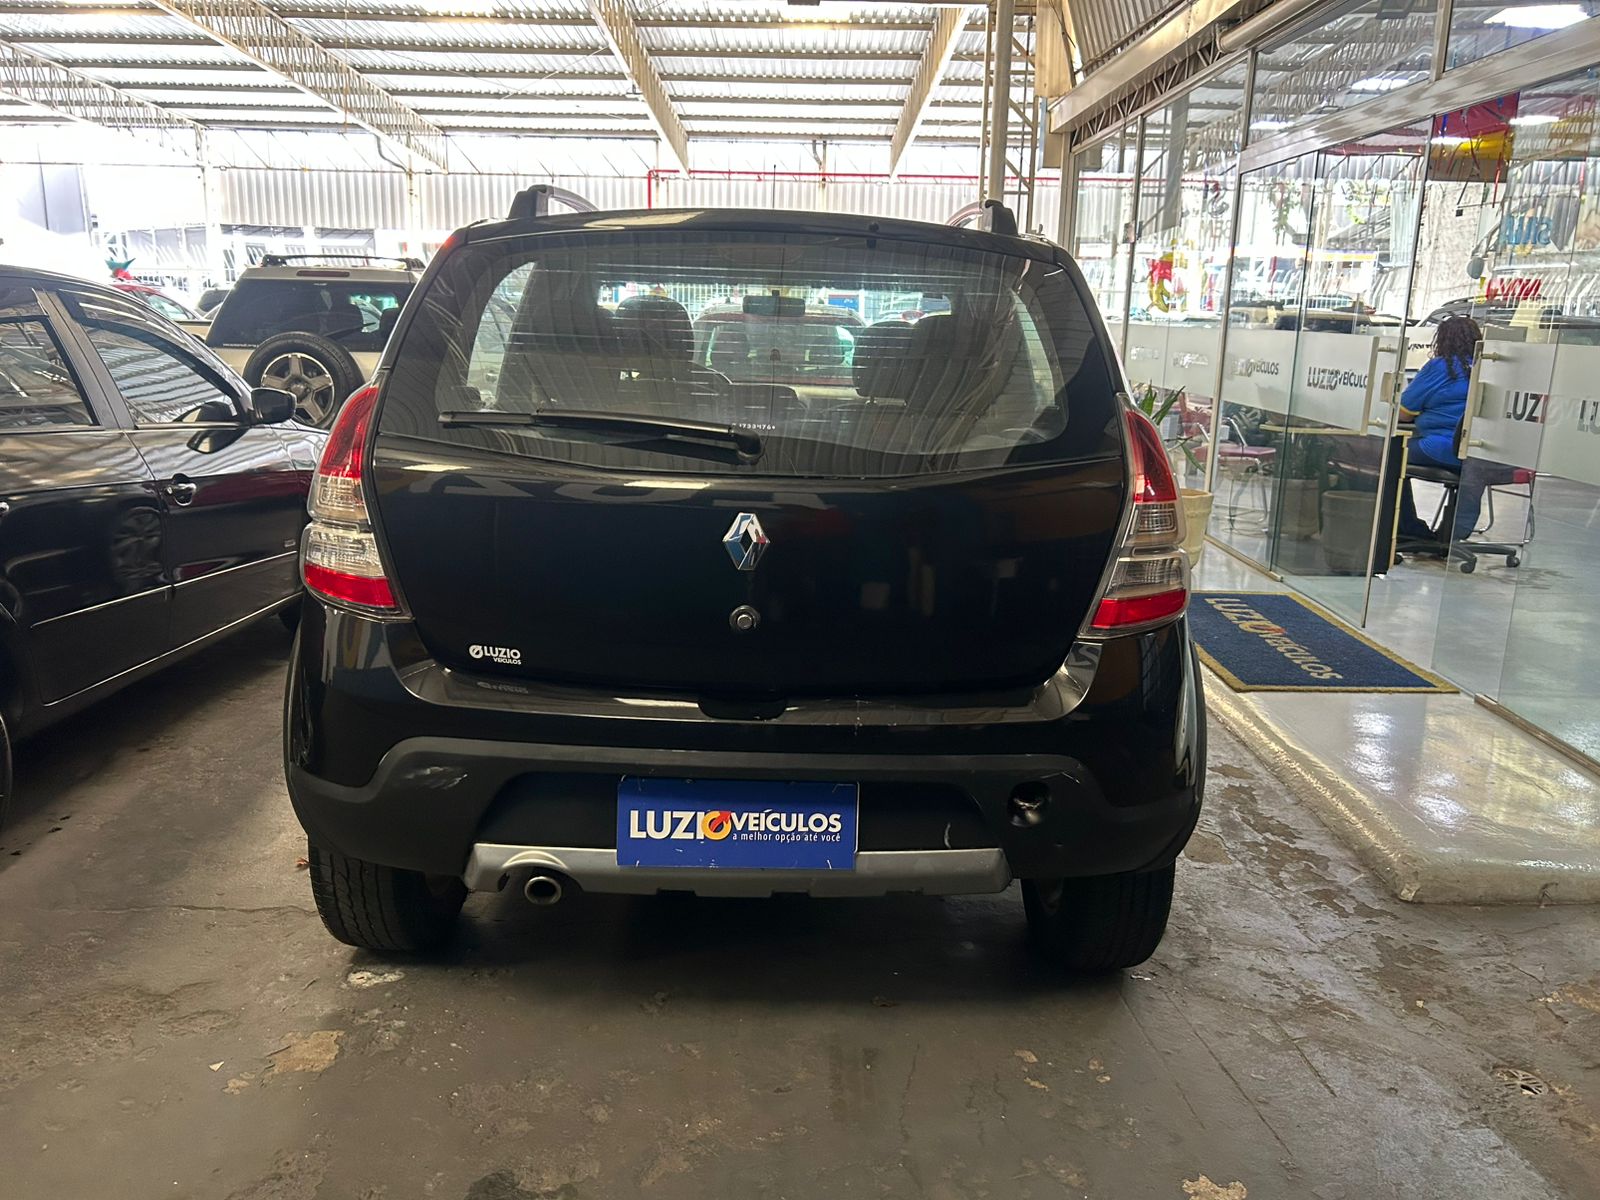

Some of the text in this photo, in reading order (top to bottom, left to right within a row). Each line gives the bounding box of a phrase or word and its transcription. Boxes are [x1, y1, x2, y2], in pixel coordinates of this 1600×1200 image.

[1204, 597, 1288, 635] LUZIO
[483, 645, 521, 659] LUZIO
[629, 808, 842, 841] LUZIO VEÍCULOS
[732, 831, 841, 843] a melhor opção até você
